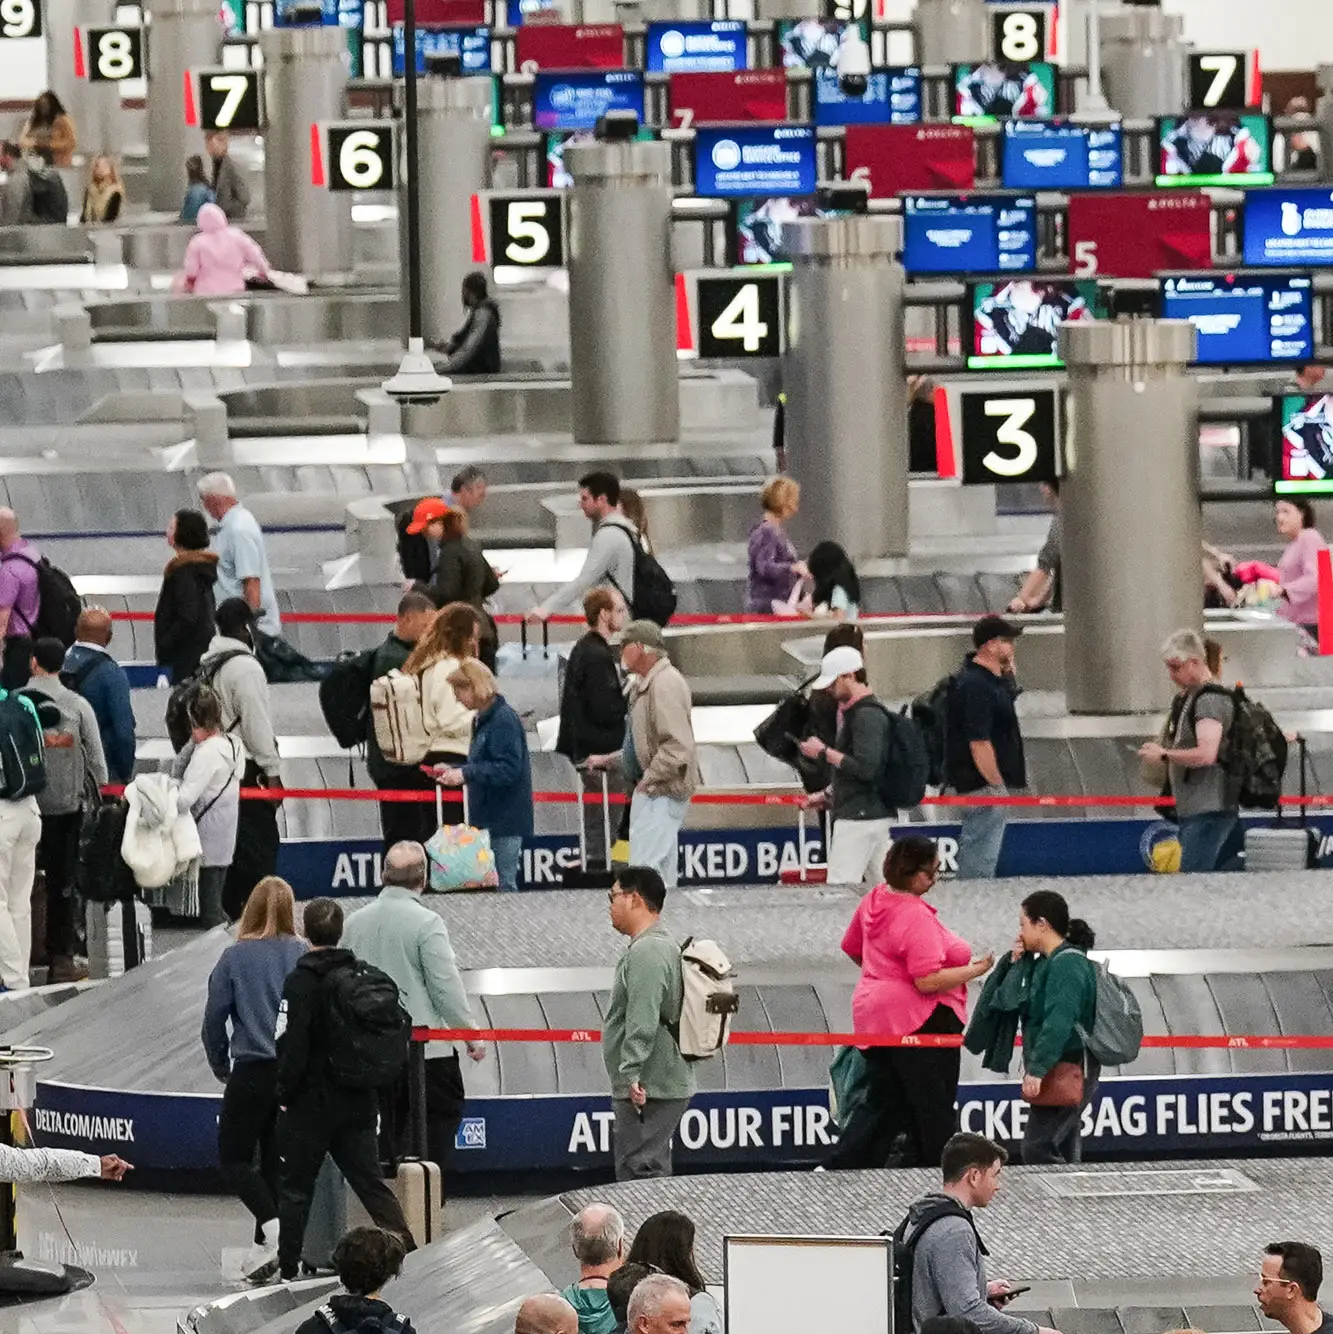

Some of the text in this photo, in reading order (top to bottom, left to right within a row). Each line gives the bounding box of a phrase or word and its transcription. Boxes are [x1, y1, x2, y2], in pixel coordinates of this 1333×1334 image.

[2, 0, 34, 37] 9
[1002, 13, 1038, 60] 8
[98, 28, 134, 79] 8
[210, 74, 249, 128] 7
[1199, 56, 1239, 107] 7
[339, 130, 384, 189] 6
[505, 201, 551, 264] 5
[1074, 241, 1099, 278] 5
[711, 284, 769, 351] 4
[982, 398, 1038, 476] 3
[901, 1035, 922, 1046] ATL
[1228, 1037, 1249, 1047] ATL
[35, 1107, 135, 1142] DELTA.COM/AMEX
[567, 1111, 617, 1152] AT
[670, 1107, 764, 1150] OUR
[1156, 1091, 1255, 1135] FLIES
